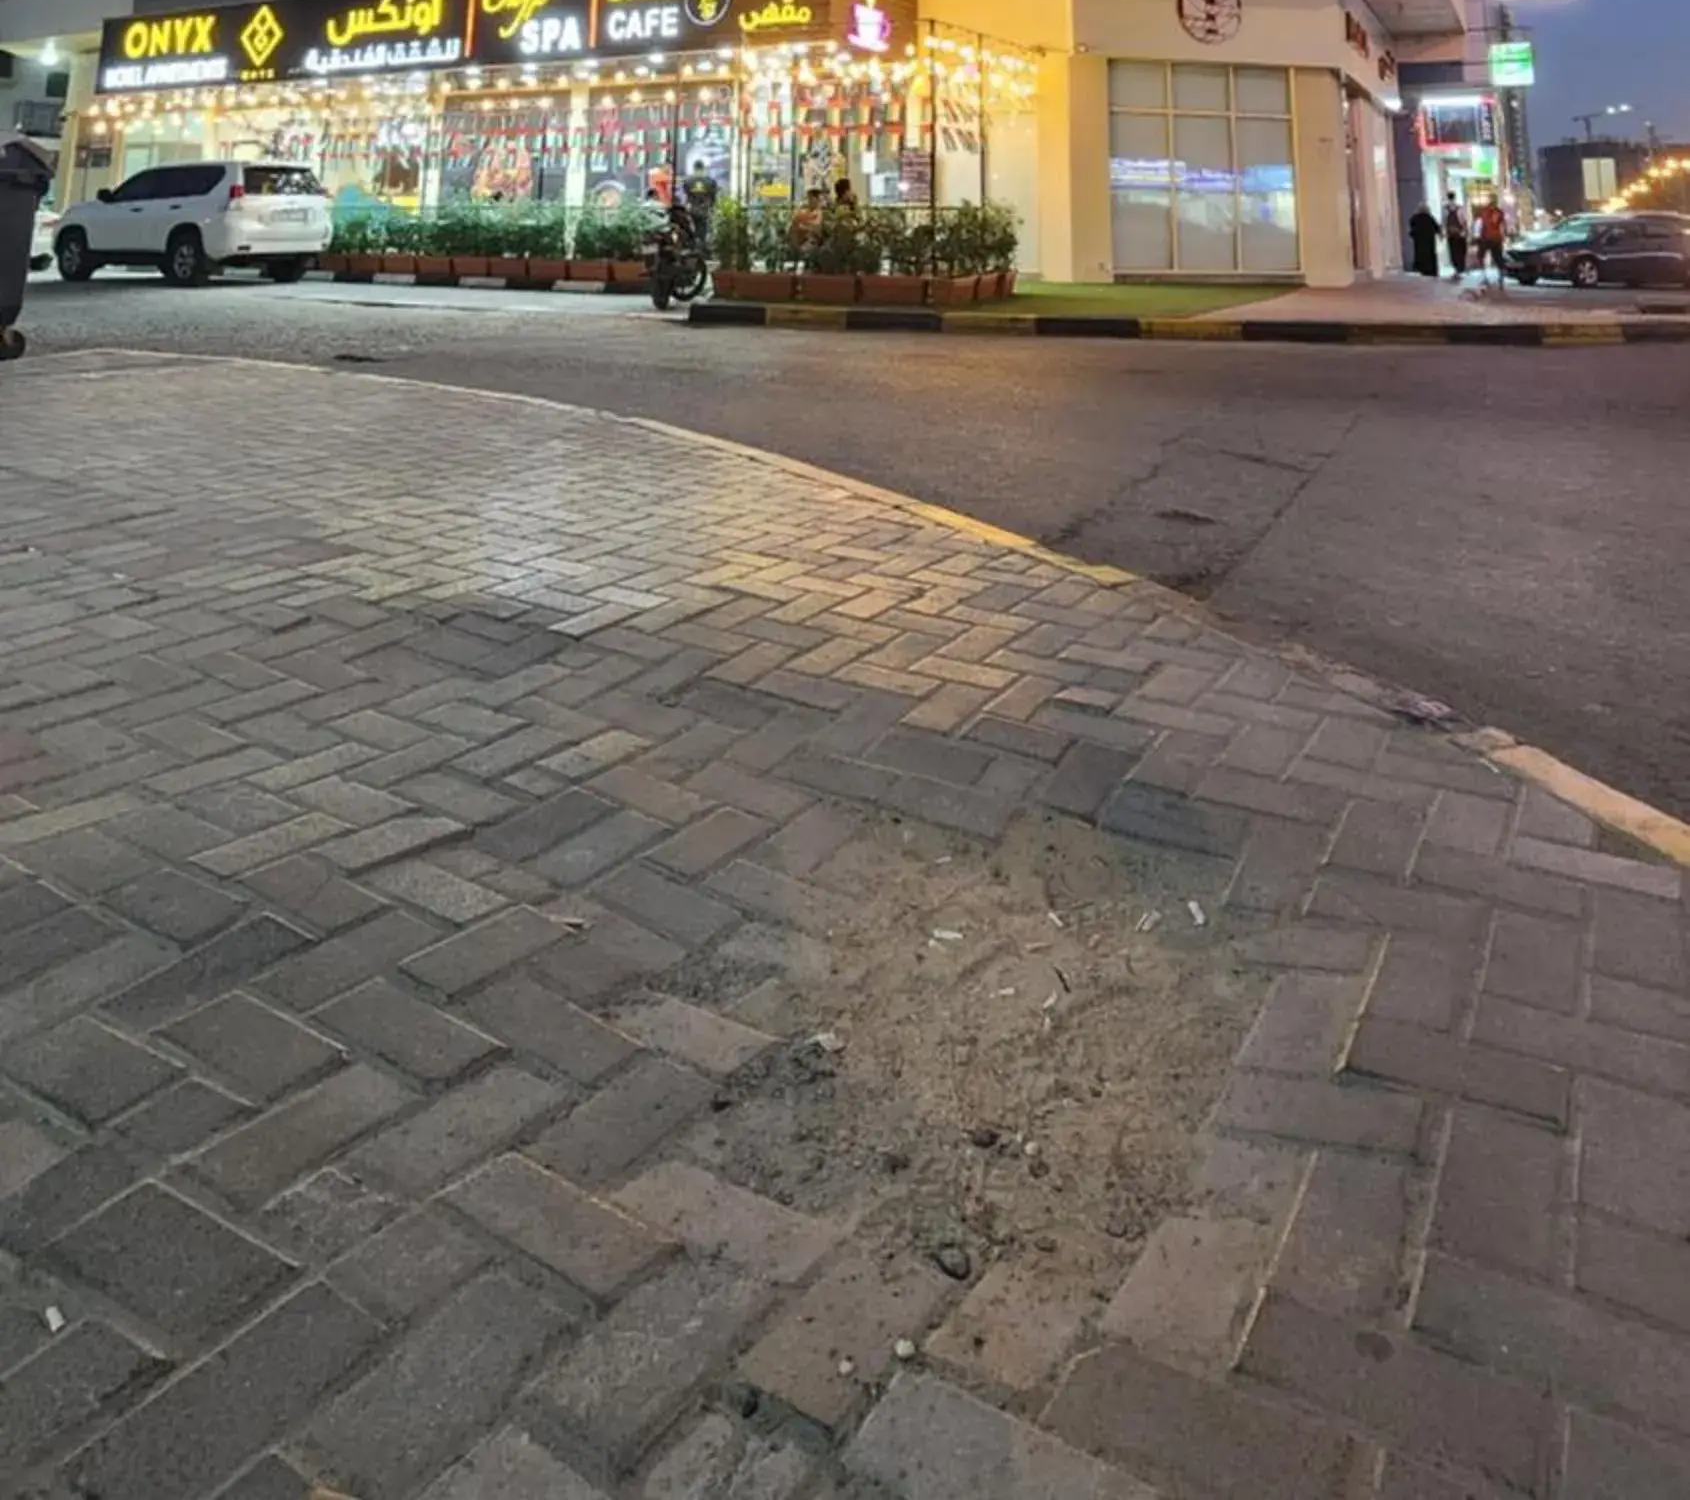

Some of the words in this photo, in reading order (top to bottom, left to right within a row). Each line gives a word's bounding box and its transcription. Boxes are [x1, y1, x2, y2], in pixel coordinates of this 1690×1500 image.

[124, 14, 216, 59] ONYX
[519, 16, 582, 55] SPA
[606, 5, 679, 41] CAFE
